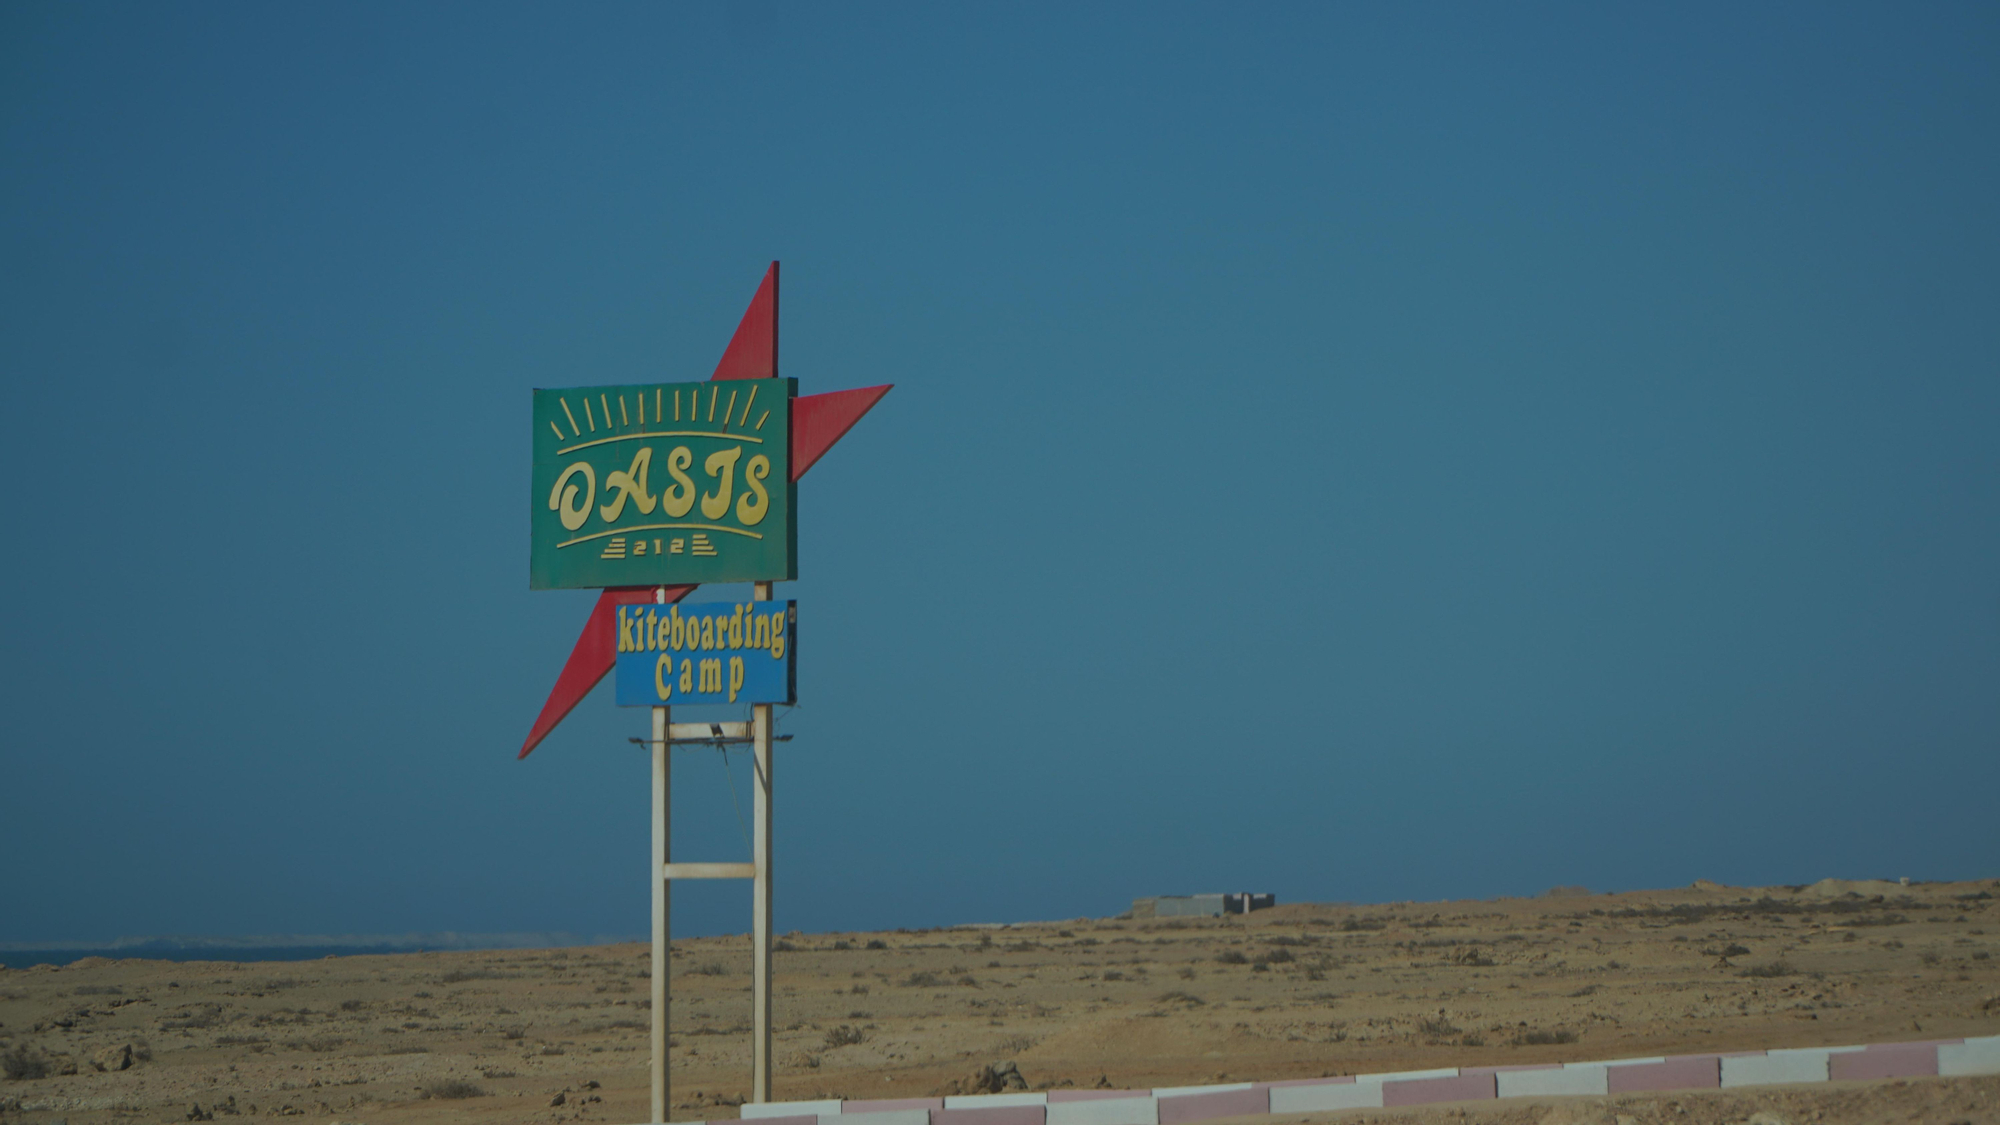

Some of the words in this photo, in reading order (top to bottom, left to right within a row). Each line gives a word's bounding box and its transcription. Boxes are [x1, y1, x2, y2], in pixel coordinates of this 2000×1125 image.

[549, 445, 770, 531] OASIS
[633, 538, 685, 556] 212
[618, 602, 785, 659] kiteboarding
[655, 653, 744, 703] Camp
